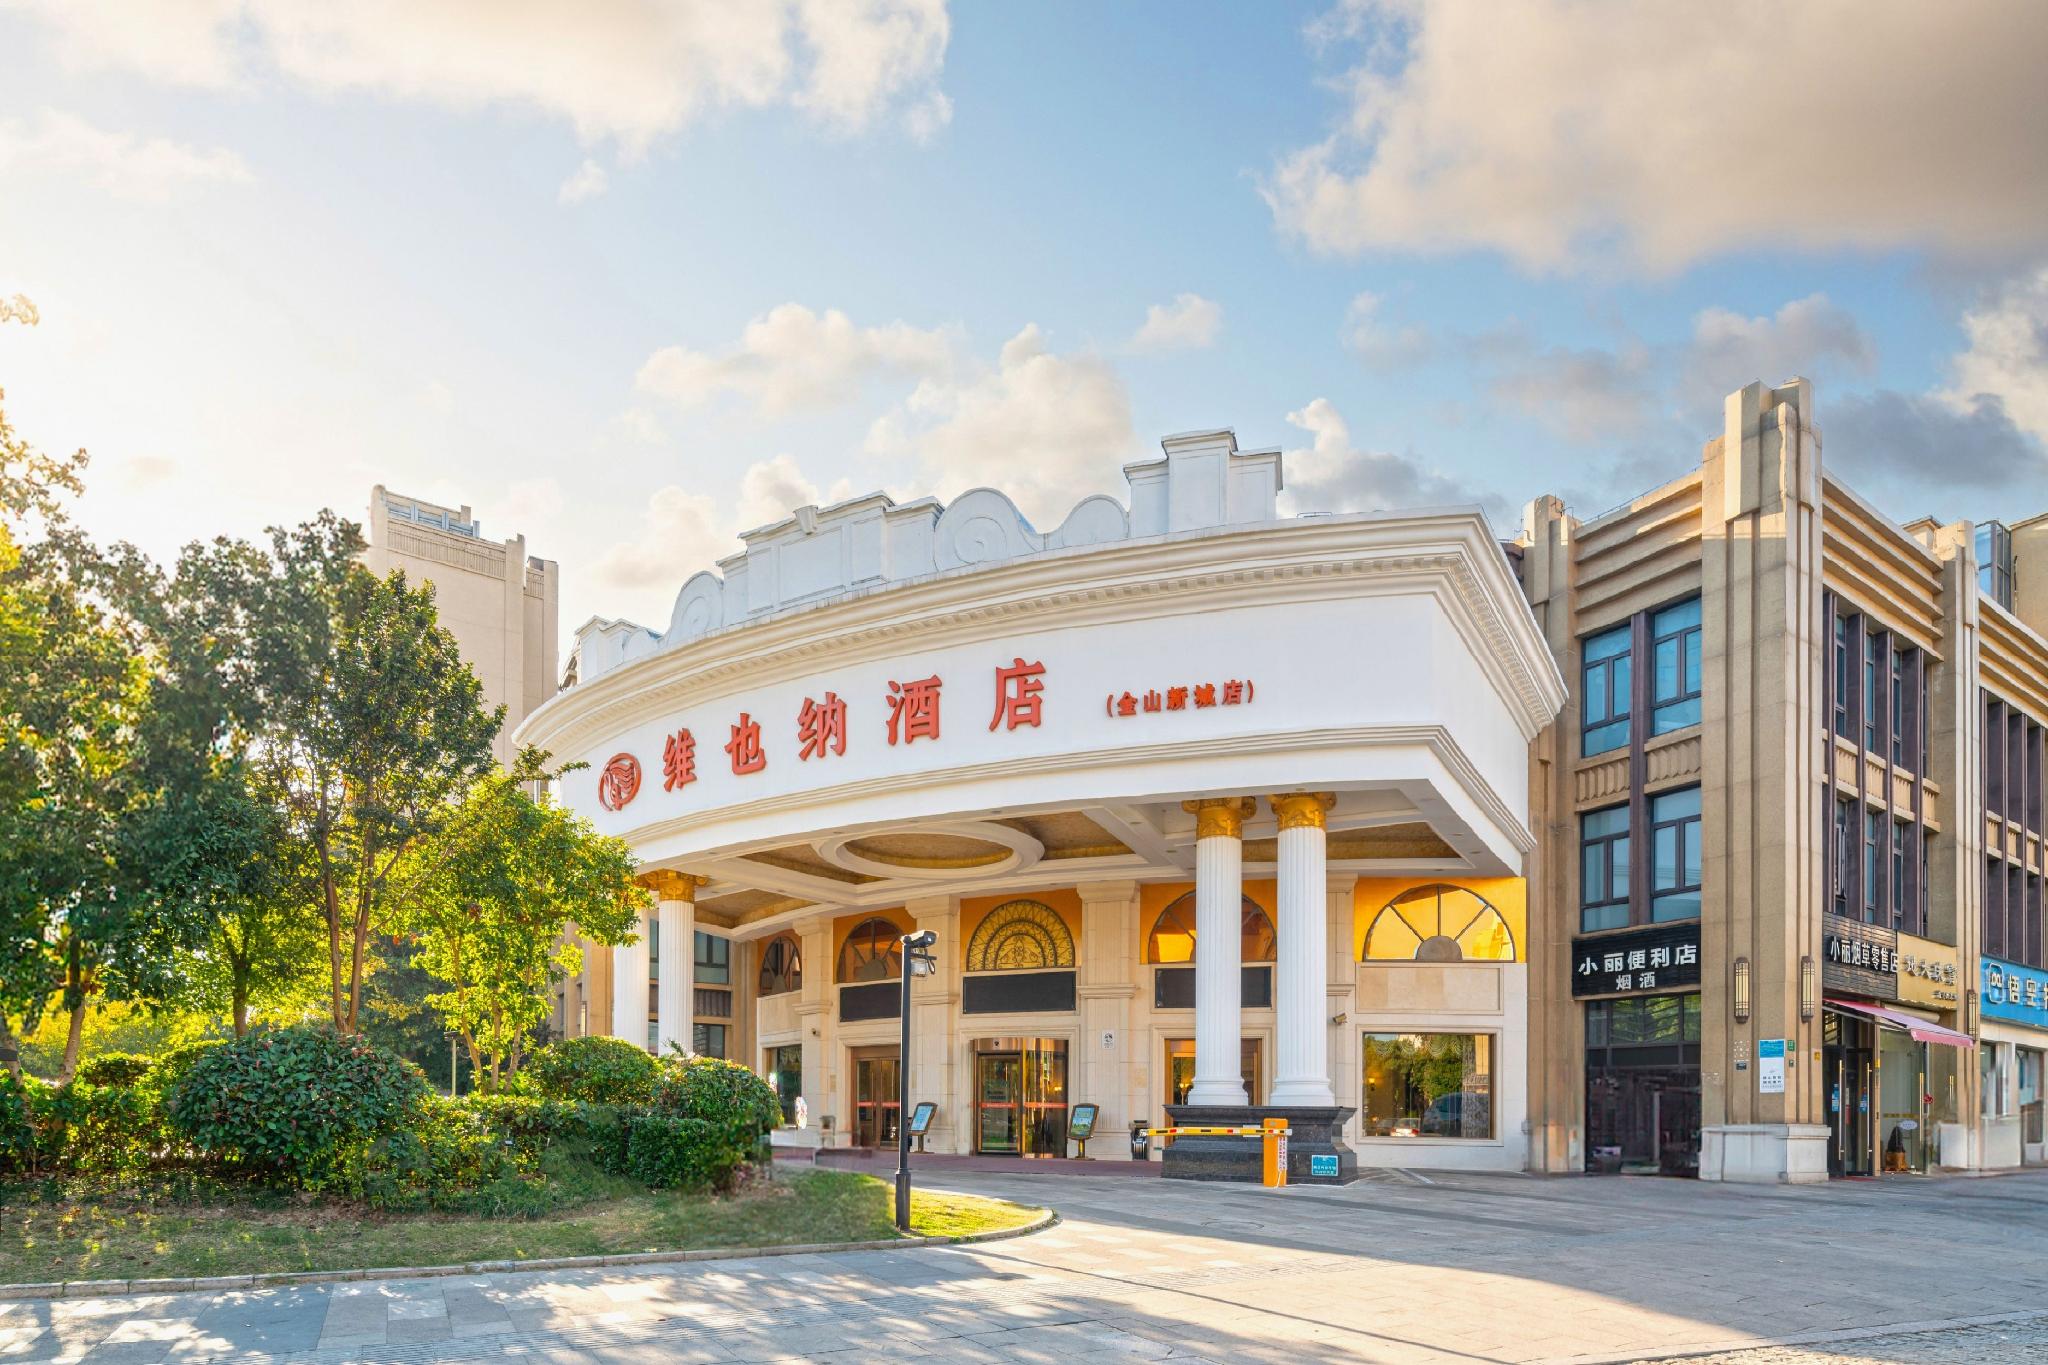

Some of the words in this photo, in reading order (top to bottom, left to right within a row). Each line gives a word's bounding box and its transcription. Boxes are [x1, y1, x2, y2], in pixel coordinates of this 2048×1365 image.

[661, 657, 1046, 792] 维也纳酒店
[1578, 944, 1697, 976] 小丽便利店
[1831, 936, 1898, 973] 小丽烟草零售店
[1615, 971, 1656, 990] 烟酒
